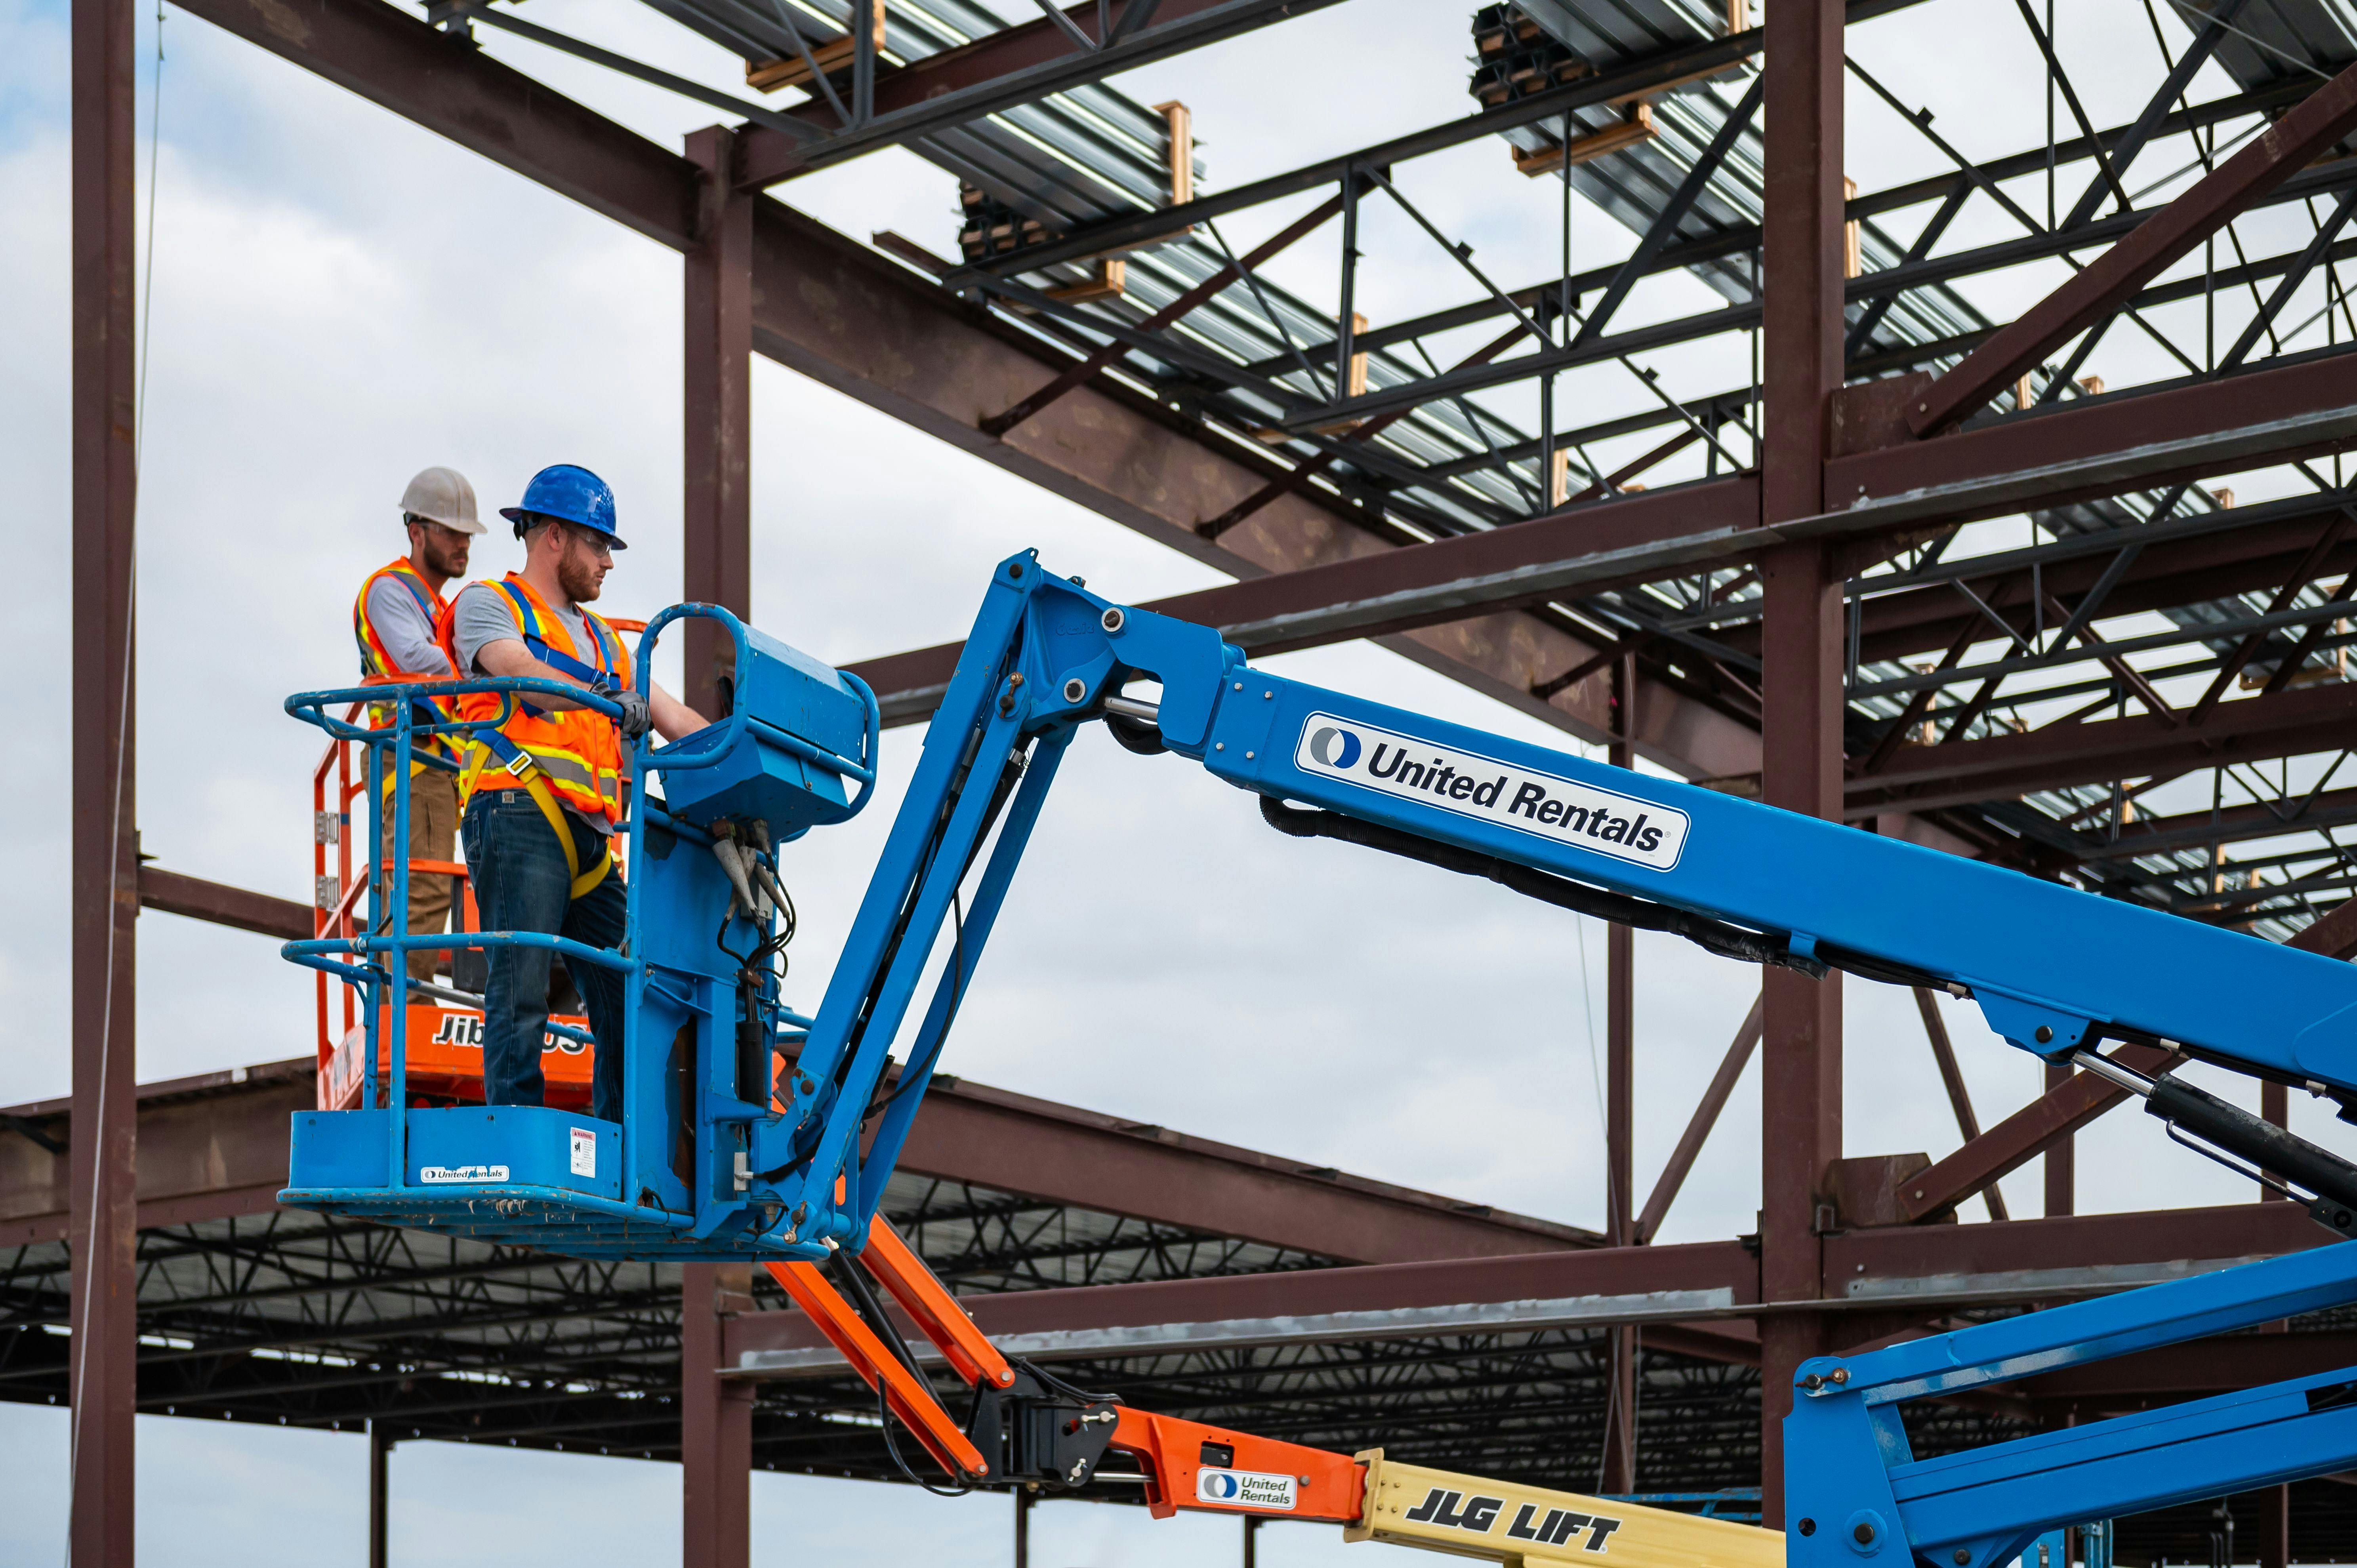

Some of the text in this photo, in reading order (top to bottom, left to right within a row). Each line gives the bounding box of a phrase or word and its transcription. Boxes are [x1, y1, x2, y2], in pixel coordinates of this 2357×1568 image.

[1055, 622, 1095, 636] Genie
[1368, 743, 1663, 852] United Rentals
[577, 1131, 593, 1140] WARNING
[438, 1170, 468, 1178] United
[1241, 1477, 1288, 1491] United
[1240, 1489, 1291, 1504] Rentals
[1405, 1488, 1622, 1551] JLG LIFT
